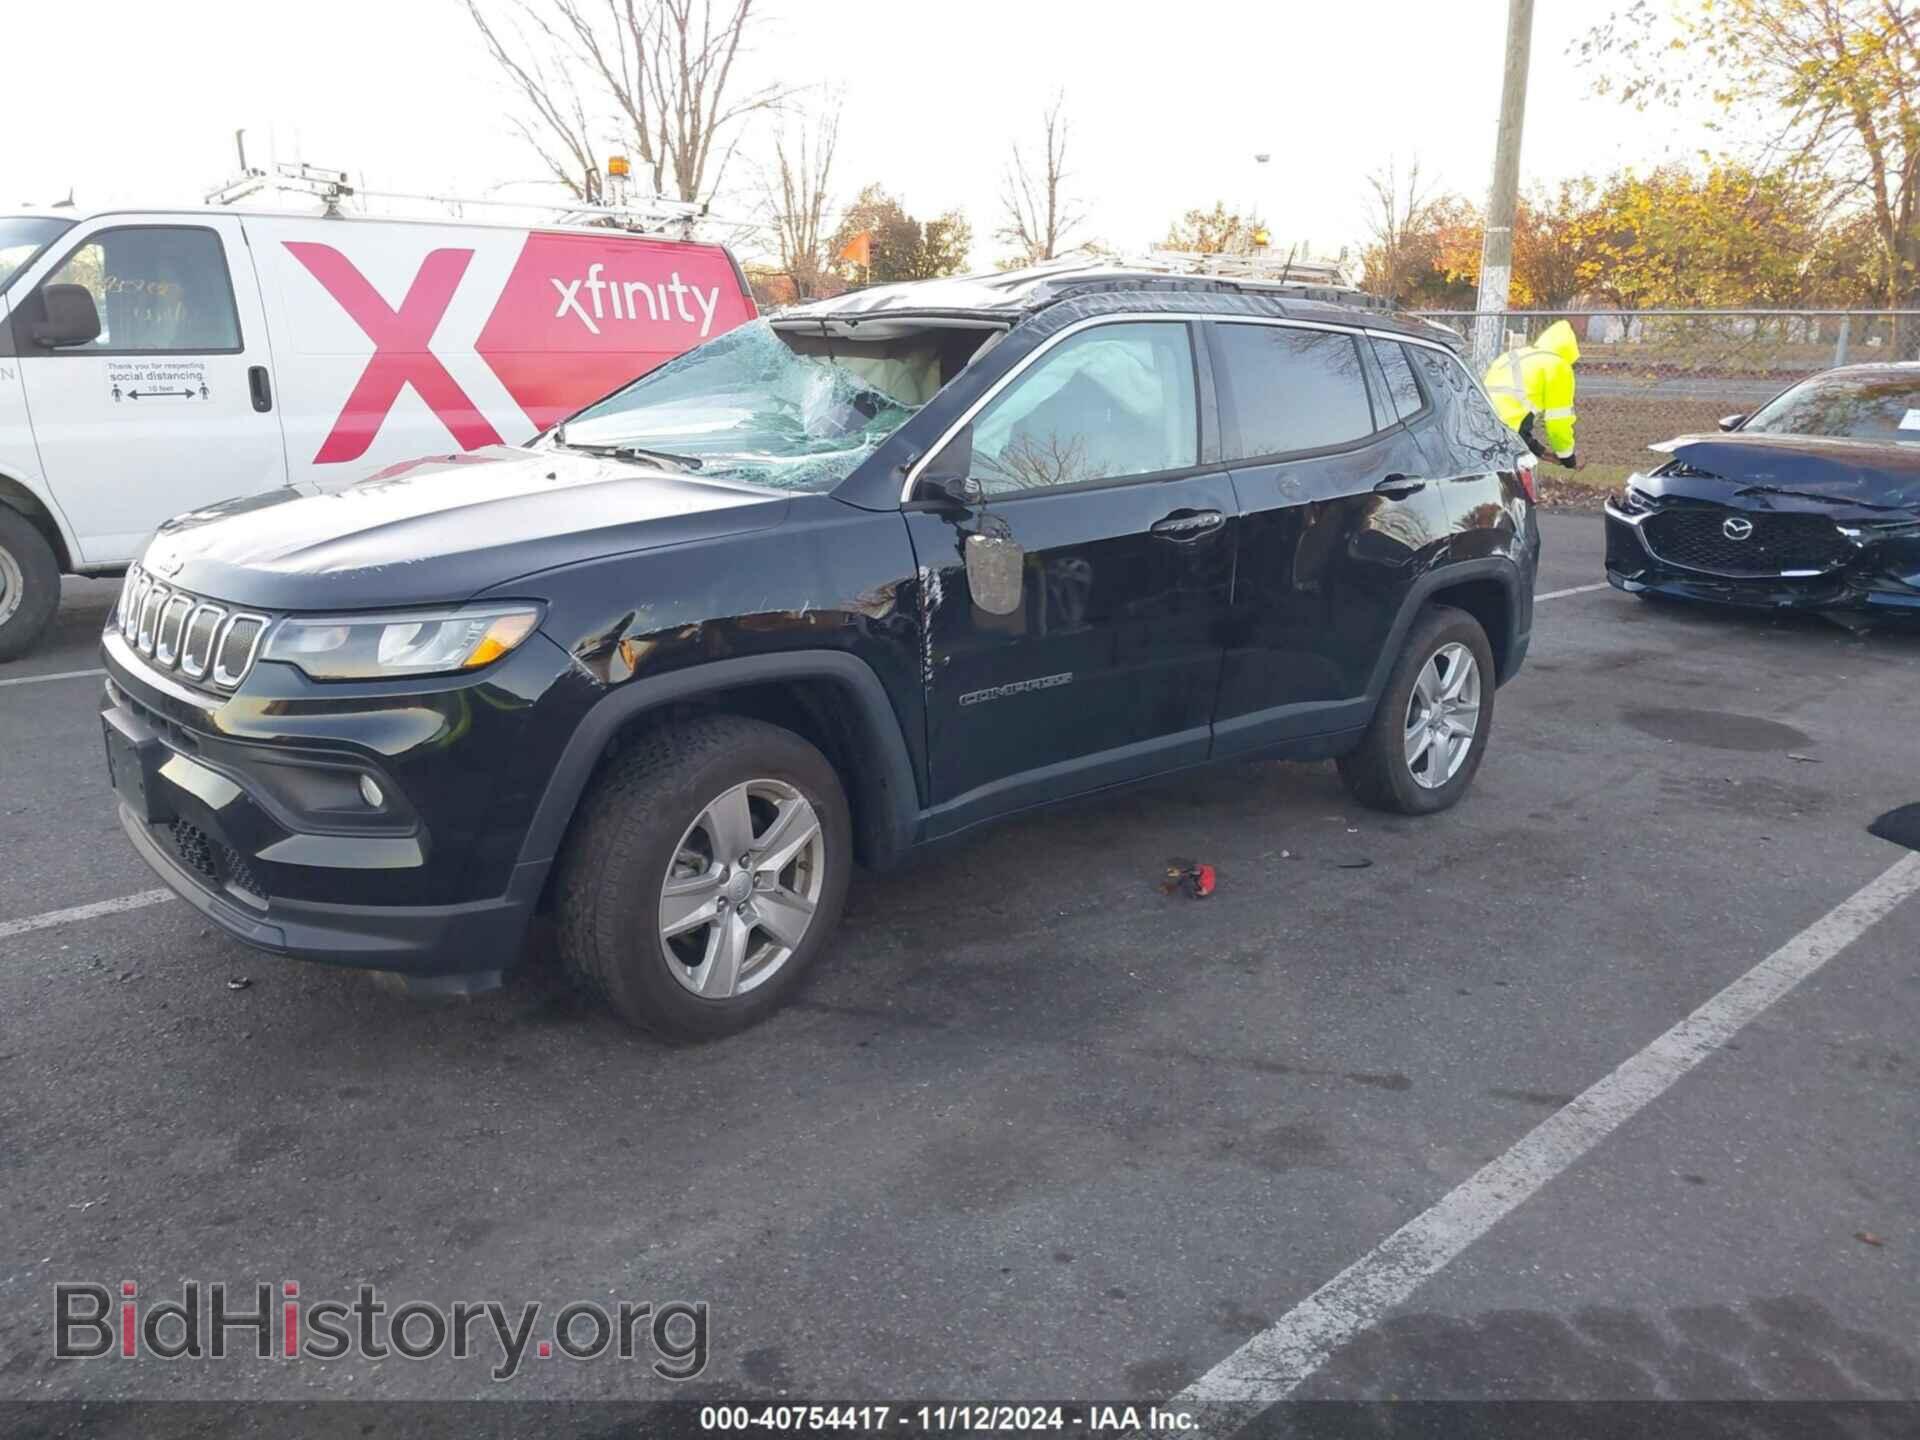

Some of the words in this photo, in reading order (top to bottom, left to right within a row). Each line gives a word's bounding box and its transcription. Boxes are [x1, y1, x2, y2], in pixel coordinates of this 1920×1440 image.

[551, 263, 719, 337] xfinity
[108, 362, 132, 370] Thank
[164, 362, 205, 370] respecting
[110, 371, 144, 381] social
[146, 370, 203, 381] distancing
